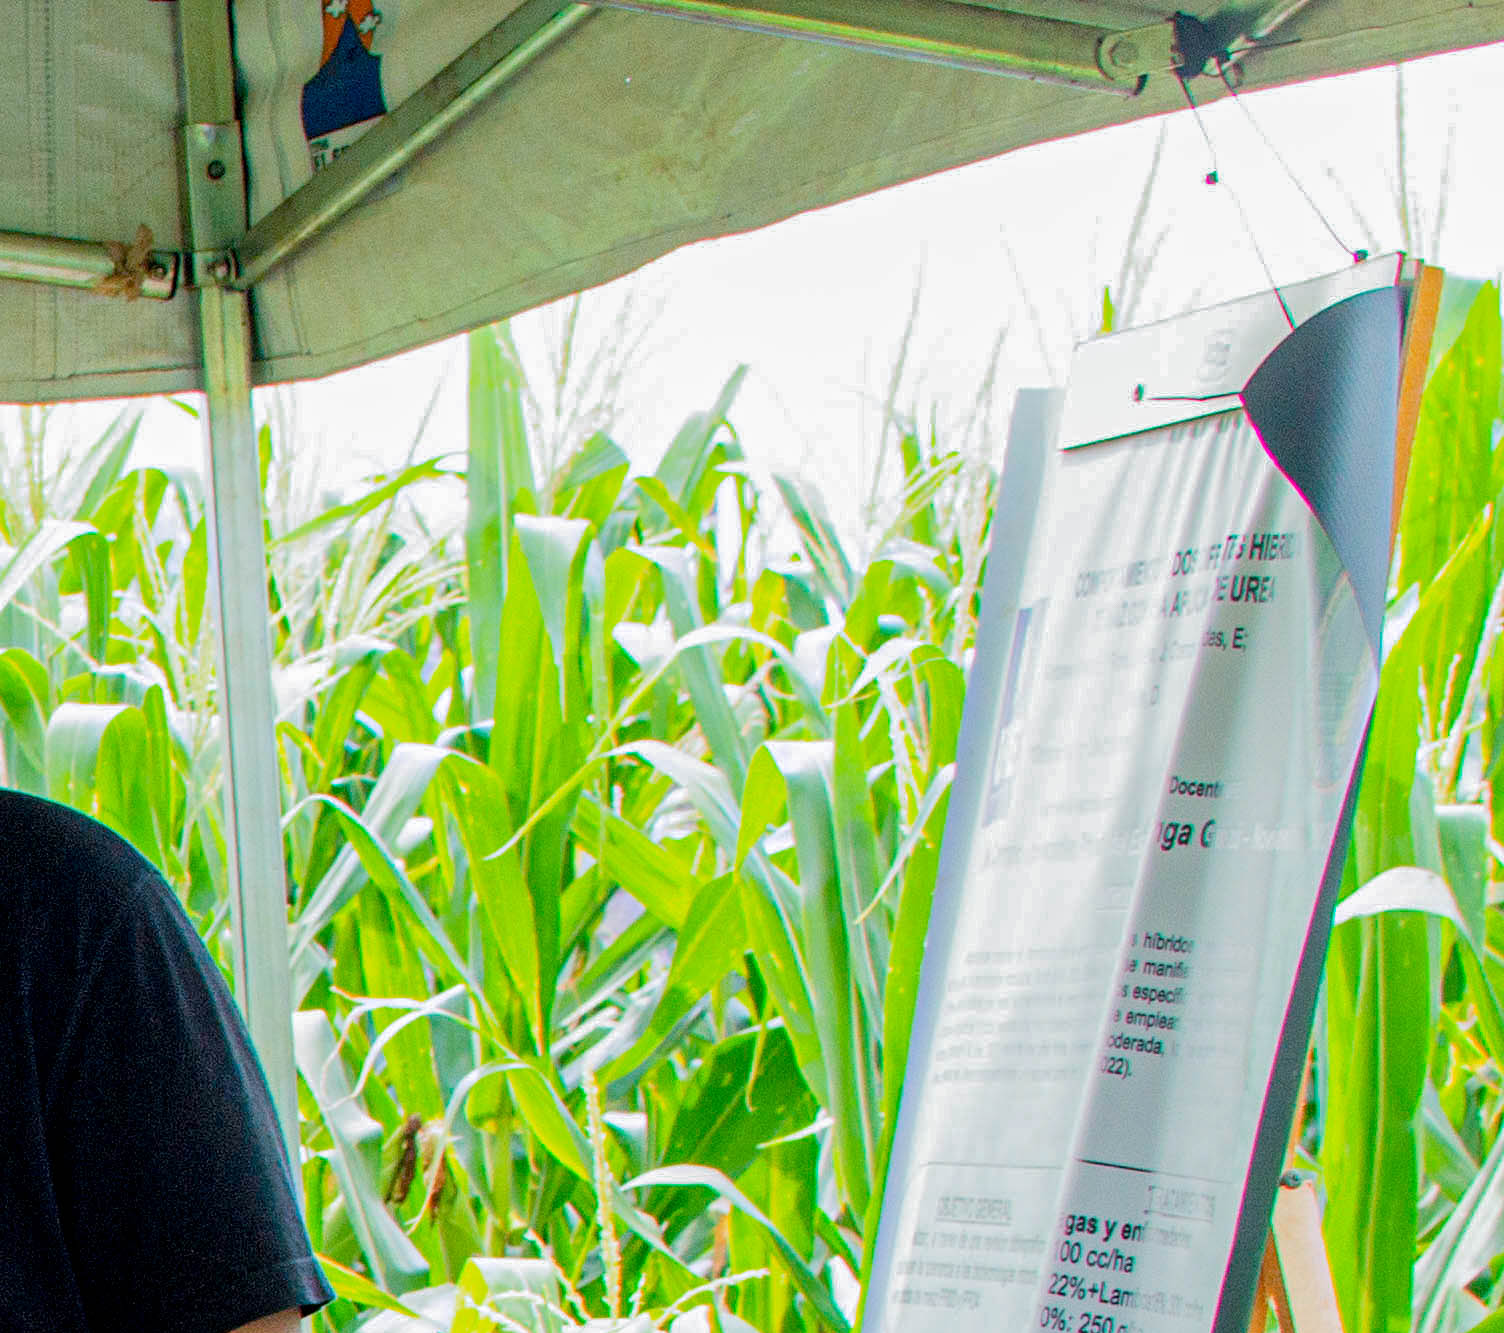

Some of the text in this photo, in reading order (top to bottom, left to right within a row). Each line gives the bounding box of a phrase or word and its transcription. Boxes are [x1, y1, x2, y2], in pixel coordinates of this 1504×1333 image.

[1169, 776, 1221, 799] Docent
[1064, 1215, 1099, 1236] gas
[1060, 1240, 1082, 1264] 00
[1086, 1248, 1136, 1273] cc/ha
[1040, 1306, 1074, 1333] 0%:
